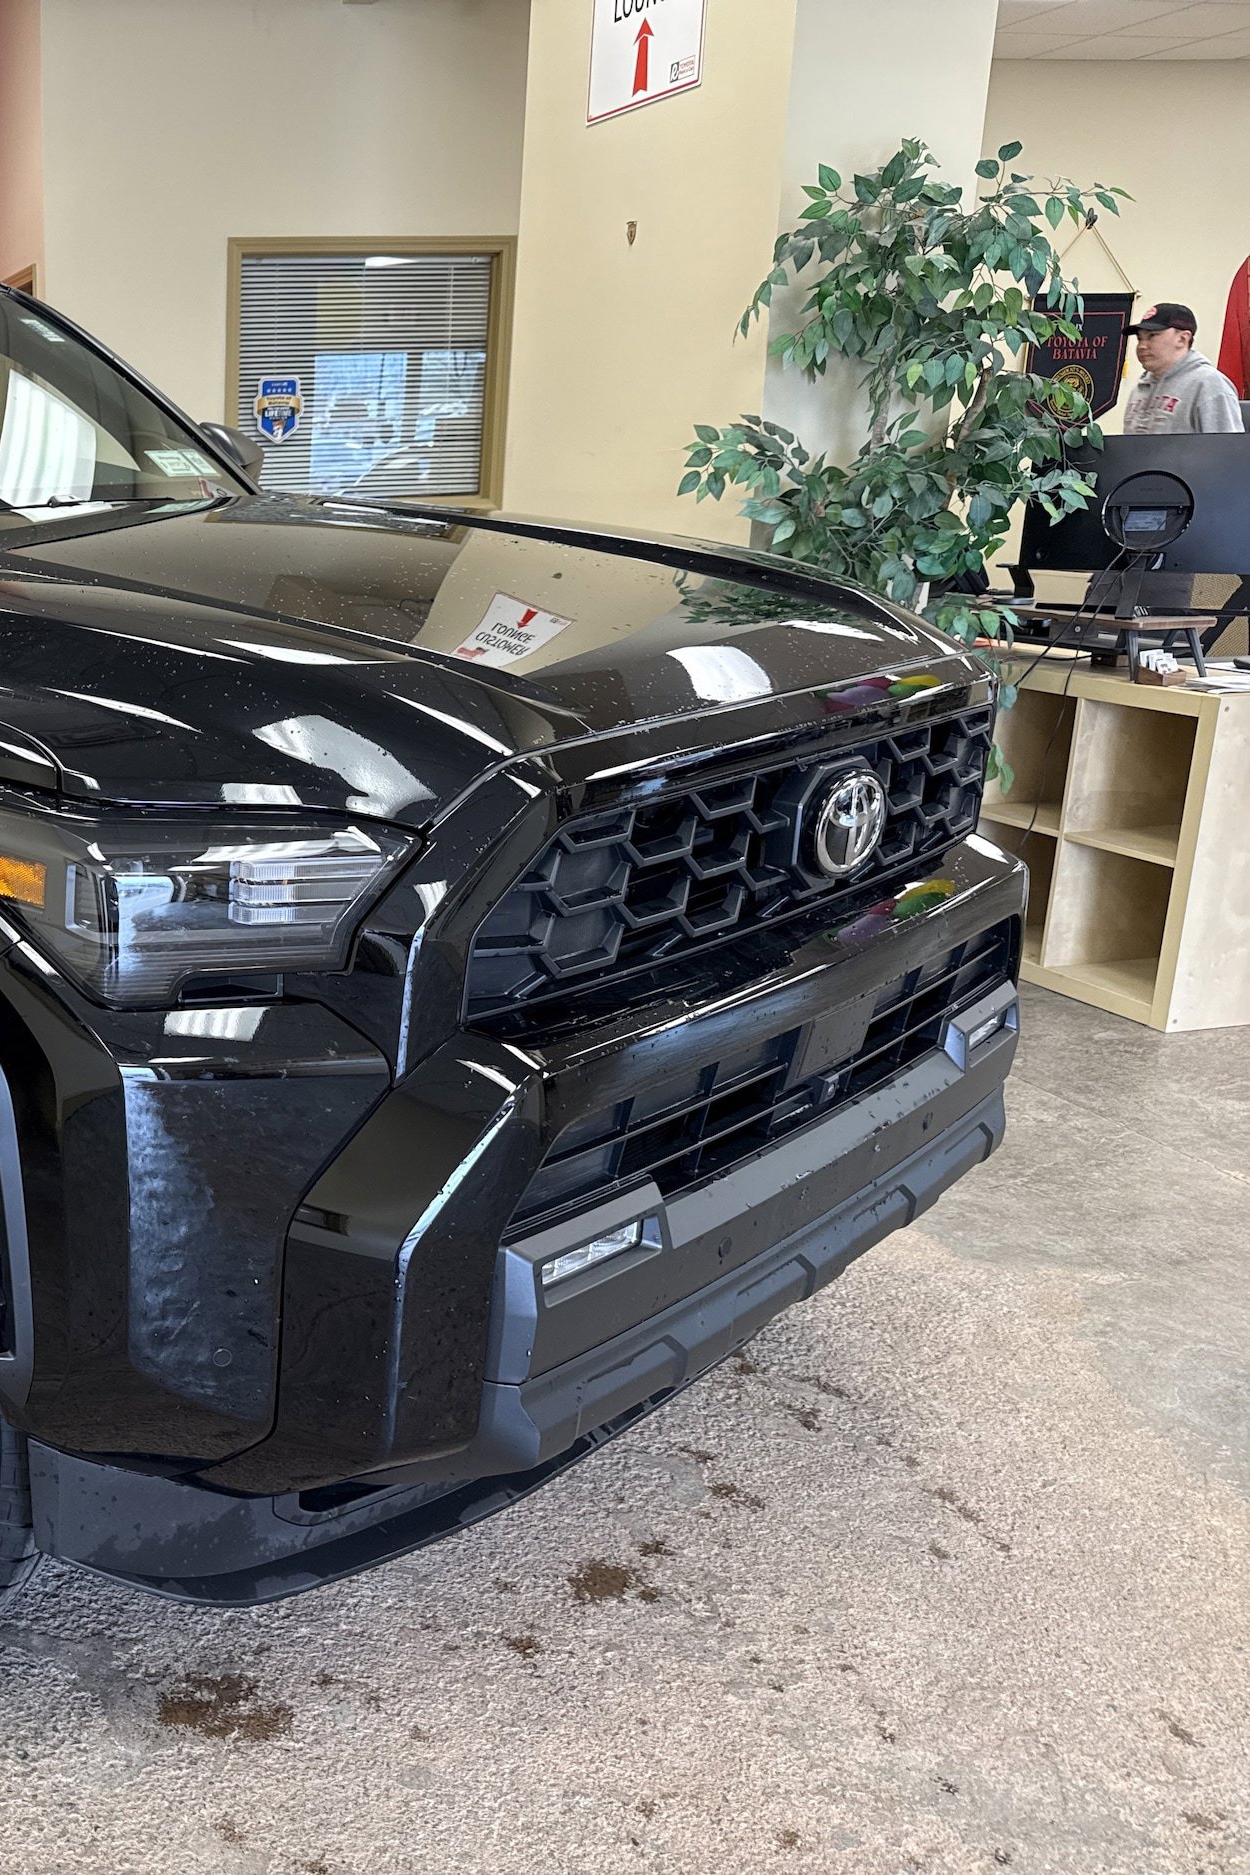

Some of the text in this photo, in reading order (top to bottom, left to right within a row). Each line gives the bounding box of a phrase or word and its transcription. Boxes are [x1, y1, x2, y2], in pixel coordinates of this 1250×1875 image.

[1047, 335, 1109, 348] TOYOTA OF
[1052, 348, 1098, 360] BATAVIA
